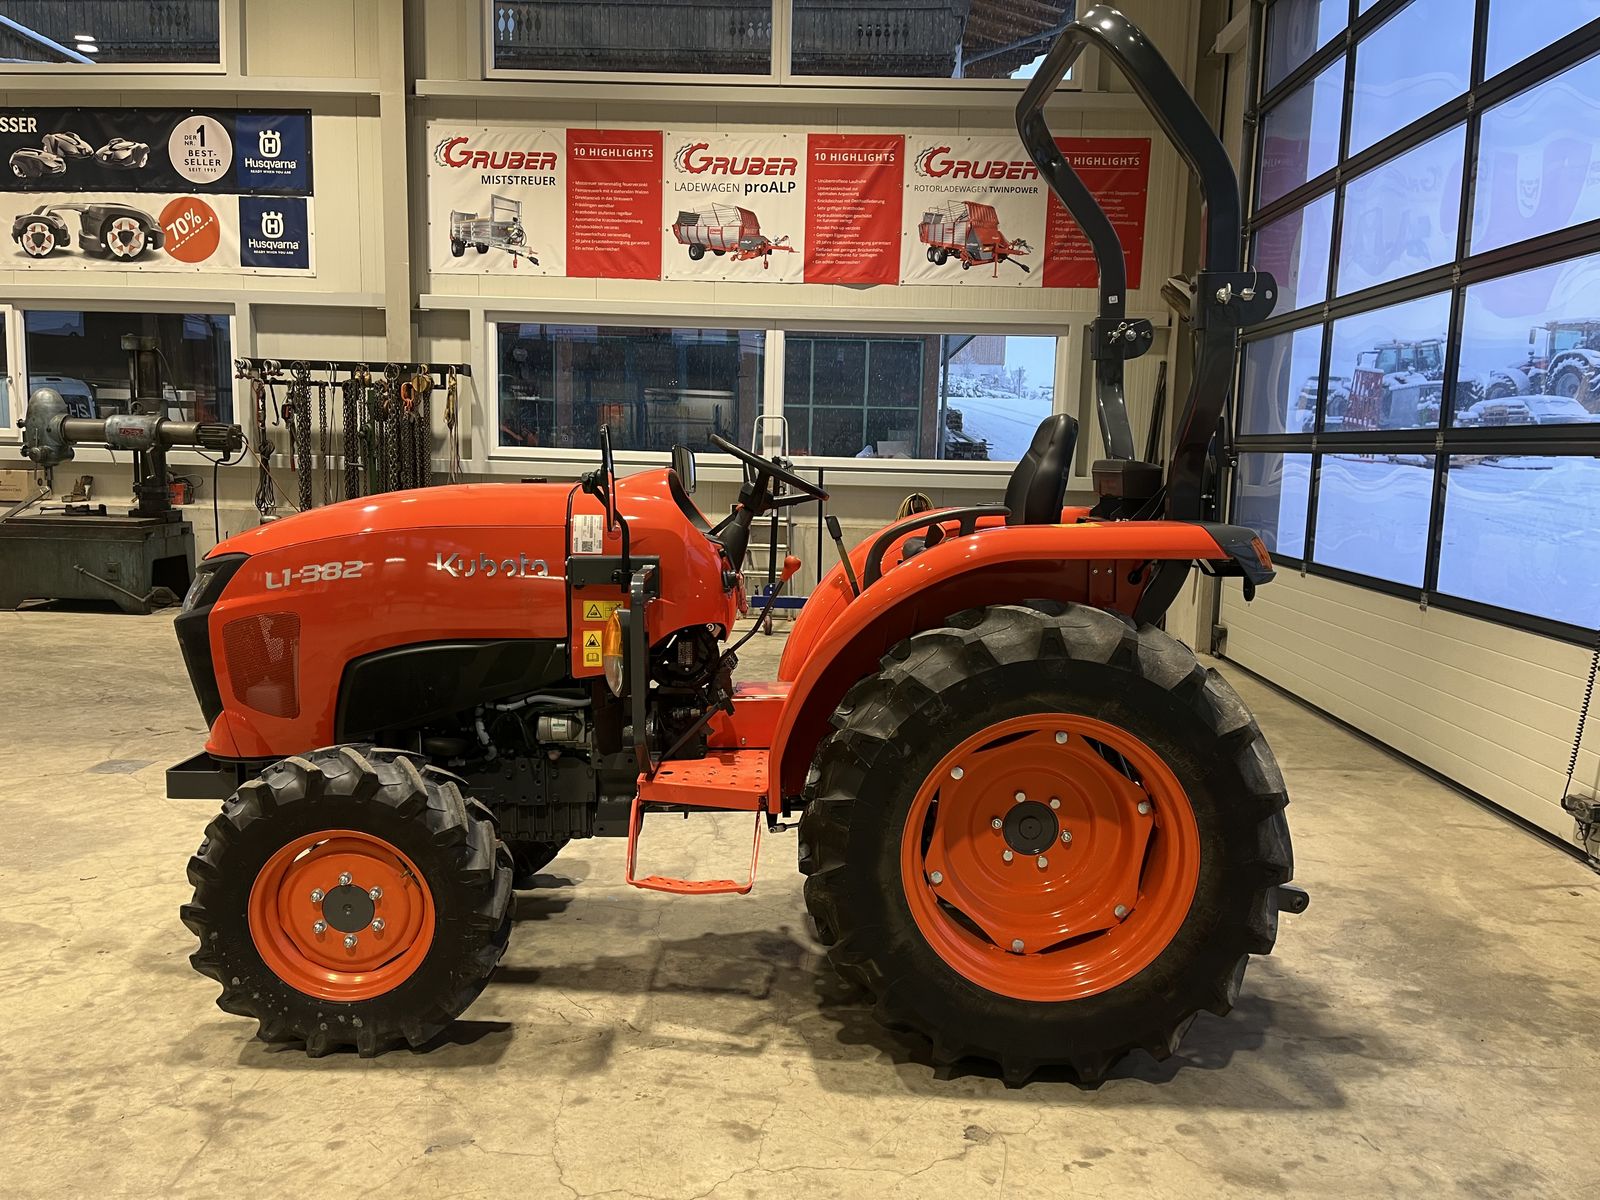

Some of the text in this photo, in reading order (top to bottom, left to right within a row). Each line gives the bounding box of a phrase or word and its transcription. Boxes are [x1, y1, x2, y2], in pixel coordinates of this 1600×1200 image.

[0, 117, 38, 133] SSER
[196, 124, 205, 147] 1
[188, 149, 217, 157] BEST-
[442, 136, 558, 171] GRUBER
[573, 147, 655, 158] 10 HIGHLIGHTS
[682, 142, 799, 176] GRUBER
[814, 152, 896, 162] 10 HIGHLIGHTS
[184, 158, 221, 166] SELLER
[244, 157, 297, 170] Husqvarna
[923, 146, 1040, 180] GRUBER
[1073, 156, 1140, 166] HIGHLIGHTS
[481, 174, 556, 186] MISTSTREUER
[674, 180, 796, 195] LADEWAGEN proALP
[914, 184, 1039, 195] ROTORLADEWAGEN TWINPOWER
[165, 207, 202, 241] 70%
[248, 238, 299, 250] Husqvarna
[436, 552, 549, 577] Kubota
[265, 560, 364, 590] L1-382
